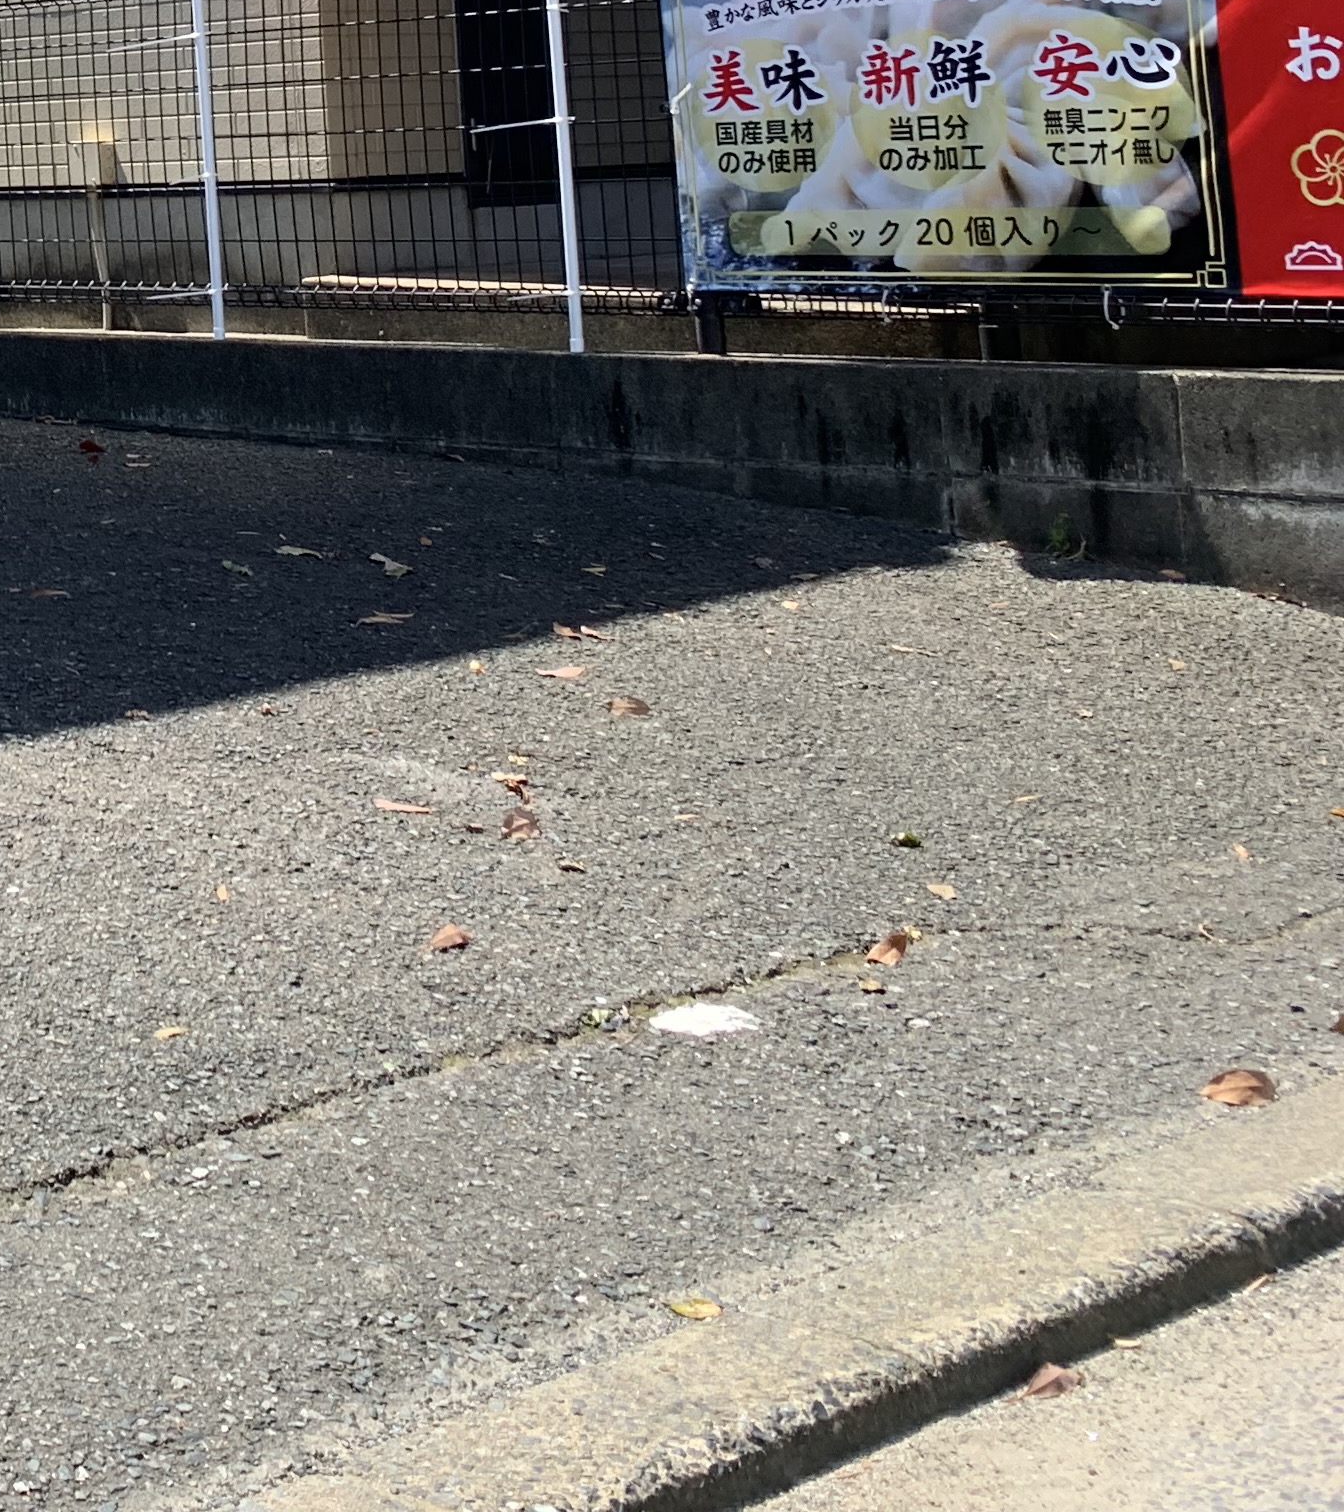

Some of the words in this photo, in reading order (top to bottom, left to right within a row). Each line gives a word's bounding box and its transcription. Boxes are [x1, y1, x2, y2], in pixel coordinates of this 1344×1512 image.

[1033, 33, 1176, 97] 安心
[1285, 26, 1344, 82] お
[703, 49, 824, 113] 美味
[861, 40, 991, 107] 新鮮
[715, 119, 814, 146] 国産具材
[889, 114, 969, 141] 当日分
[1043, 105, 1171, 136] 無臭ニンニク
[718, 148, 817, 174] のみ使用
[879, 144, 987, 172] のみ加工
[1046, 138, 1176, 167] でニオイ無し
